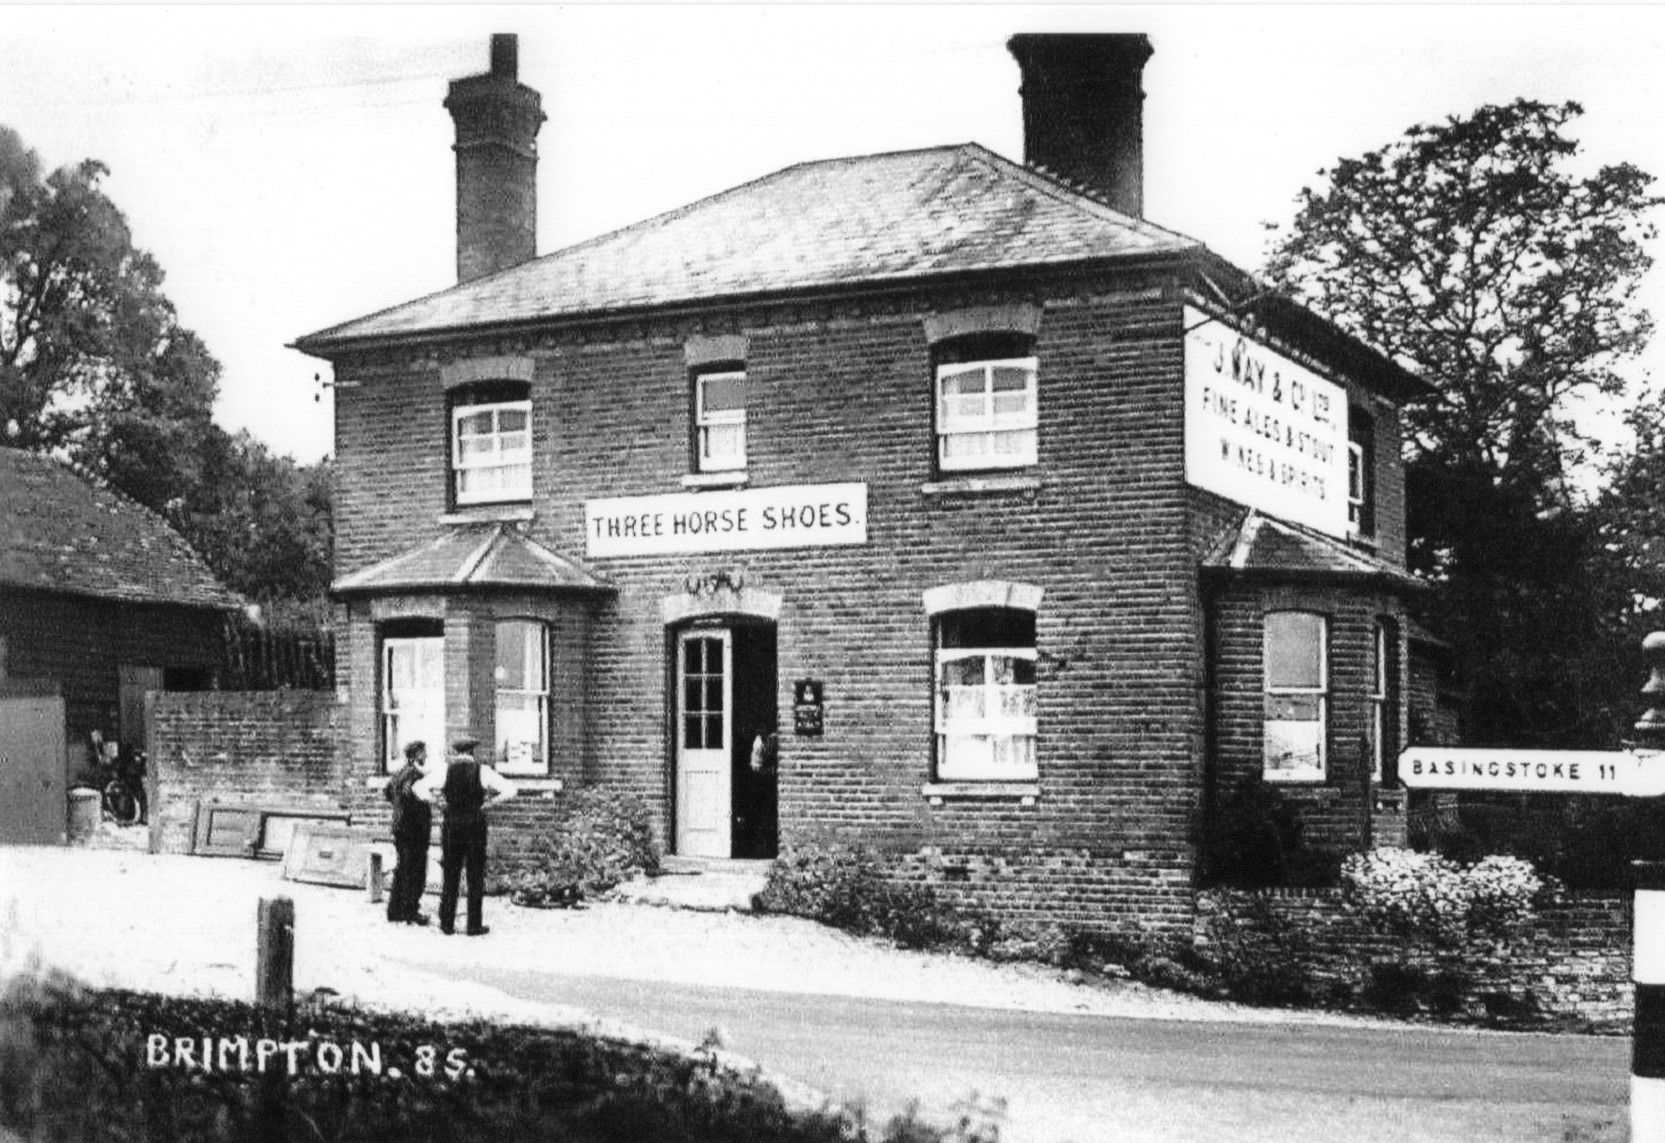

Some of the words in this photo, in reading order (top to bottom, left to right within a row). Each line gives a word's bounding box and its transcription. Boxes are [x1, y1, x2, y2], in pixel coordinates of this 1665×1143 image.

[1272, 371, 1283, 404] &
[1202, 386, 1238, 426] FINE
[1243, 406, 1281, 443] ALES
[593, 514, 665, 538] THREE
[673, 507, 749, 536] HORSE
[762, 501, 860, 531] SHOES.
[1412, 758, 1581, 780] BASINGSTOKE
[1599, 763, 1616, 780] 11
